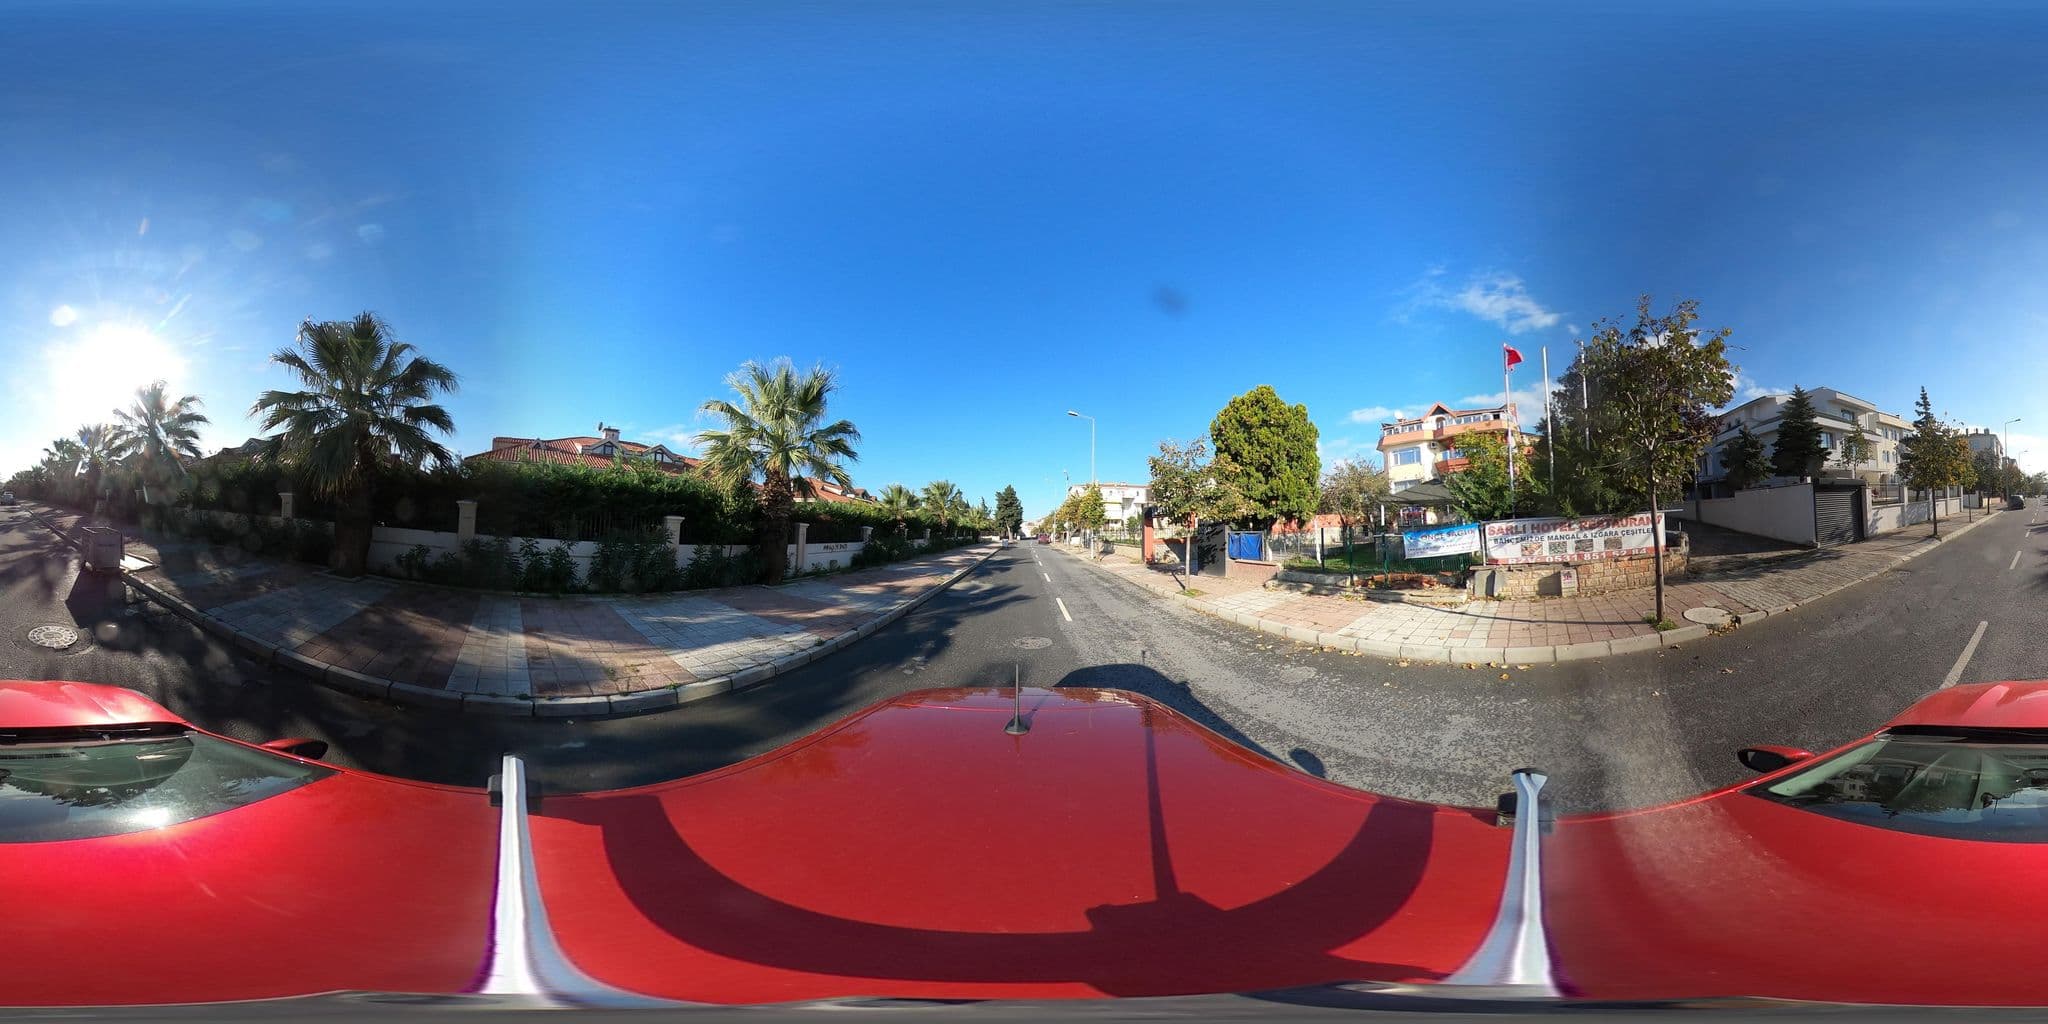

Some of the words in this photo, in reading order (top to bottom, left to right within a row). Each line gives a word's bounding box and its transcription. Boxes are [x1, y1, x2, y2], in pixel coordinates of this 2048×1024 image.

[1531, 520, 1575, 534] HOTEL
[1547, 532, 1581, 542] MANGAL
[1591, 530, 1619, 539] IZGARA
[1621, 526, 1655, 538] ÇEŞİTLE
[1583, 552, 1606, 561] 851
